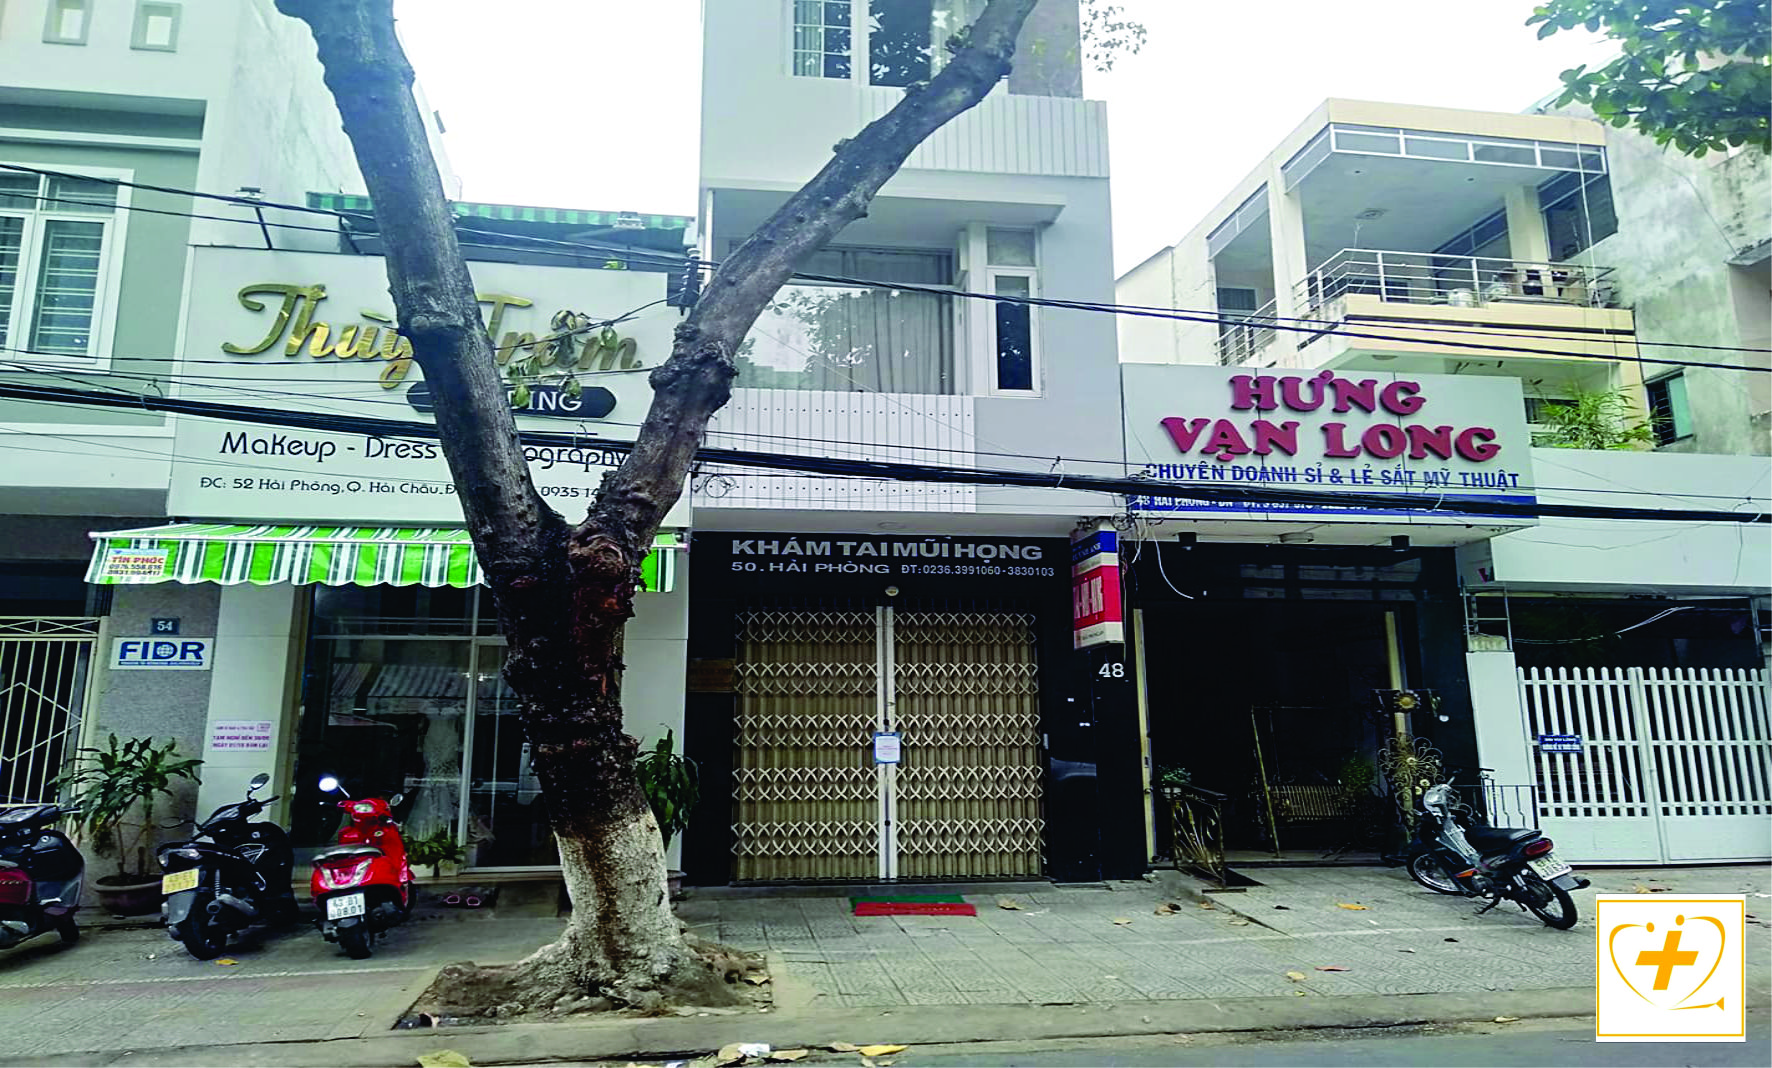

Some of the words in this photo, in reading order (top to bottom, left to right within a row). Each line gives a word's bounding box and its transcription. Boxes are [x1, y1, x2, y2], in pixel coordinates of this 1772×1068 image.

[221, 284, 413, 389] Thùy
[1229, 370, 1427, 416] HƯNG
[364, 436, 438, 459] Dress
[1160, 417, 1301, 462] VẠN
[1321, 422, 1501, 462] LONG
[200, 477, 226, 489] ĐC:
[232, 478, 254, 489] 52
[541, 486, 579, 497] 0935
[1145, 461, 1224, 480] CHUYÊN
[1232, 465, 1297, 482] DOANH
[1305, 462, 1323, 483] SỈ
[1329, 468, 1343, 484] &
[1351, 463, 1373, 484] LẺ
[1381, 464, 1416, 485] SẮT
[1424, 468, 1450, 486] MỸ
[1459, 469, 1519, 491] THUẬT
[732, 537, 831, 556] KHÁM
[836, 541, 888, 557] TAI
[954, 543, 1043, 563] HỌNG
[815, 560, 890, 573] PHÒNG
[157, 621, 173, 631] 54
[120, 641, 205, 660] FIDR
[1098, 663, 1125, 678] 48
